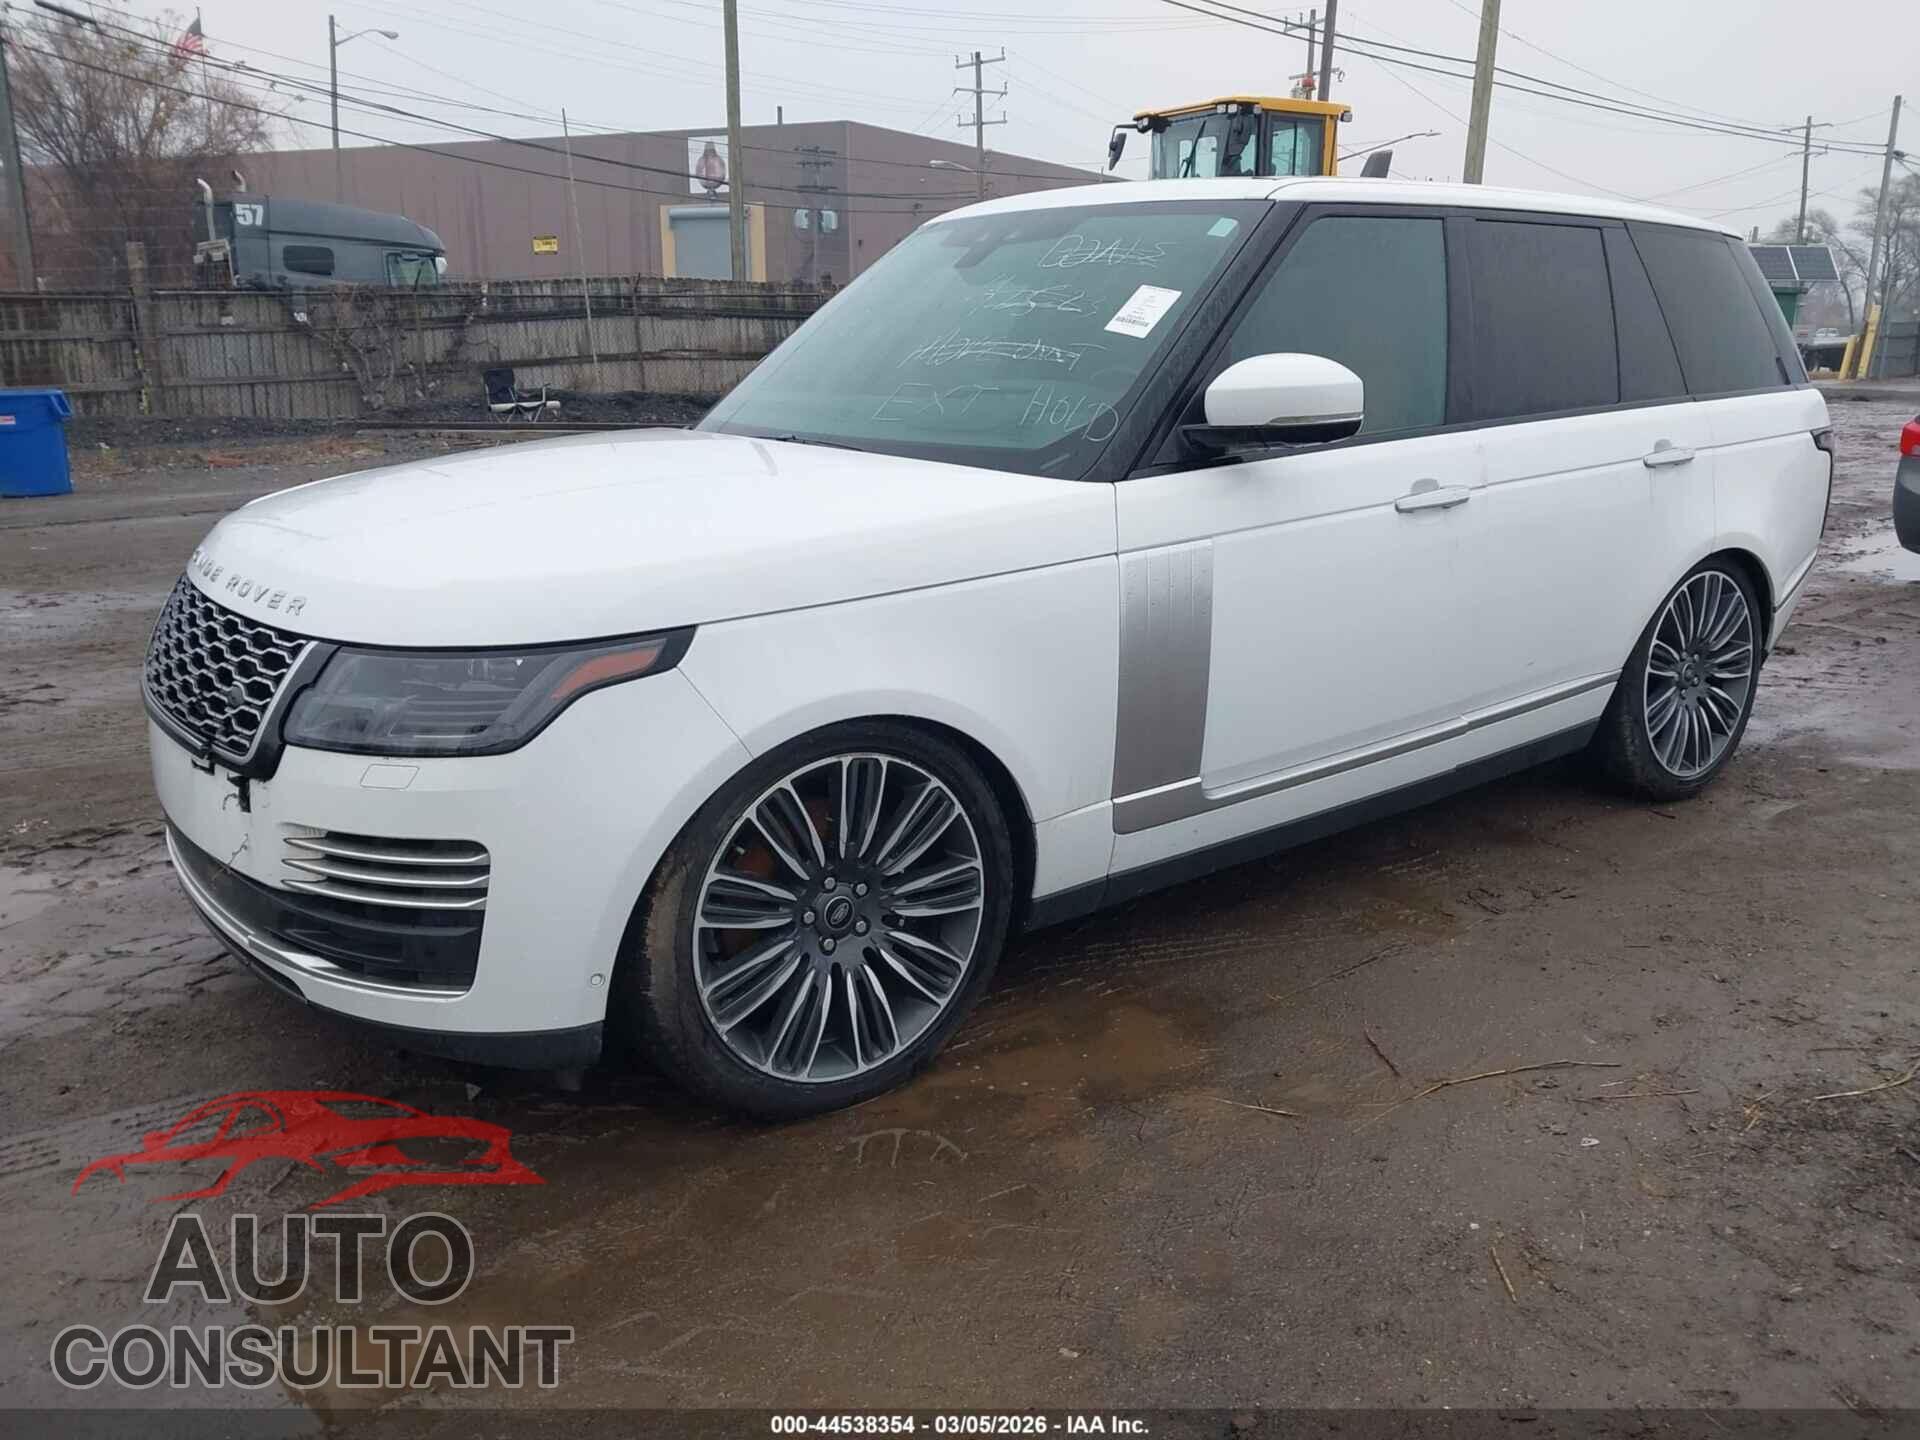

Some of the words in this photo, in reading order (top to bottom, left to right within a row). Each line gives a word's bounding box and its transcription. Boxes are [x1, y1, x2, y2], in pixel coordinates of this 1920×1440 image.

[235, 204, 264, 226] 57
[872, 382, 1000, 421] EXT
[1019, 383, 1120, 442] HOLD
[225, 574, 307, 616] ROVER
